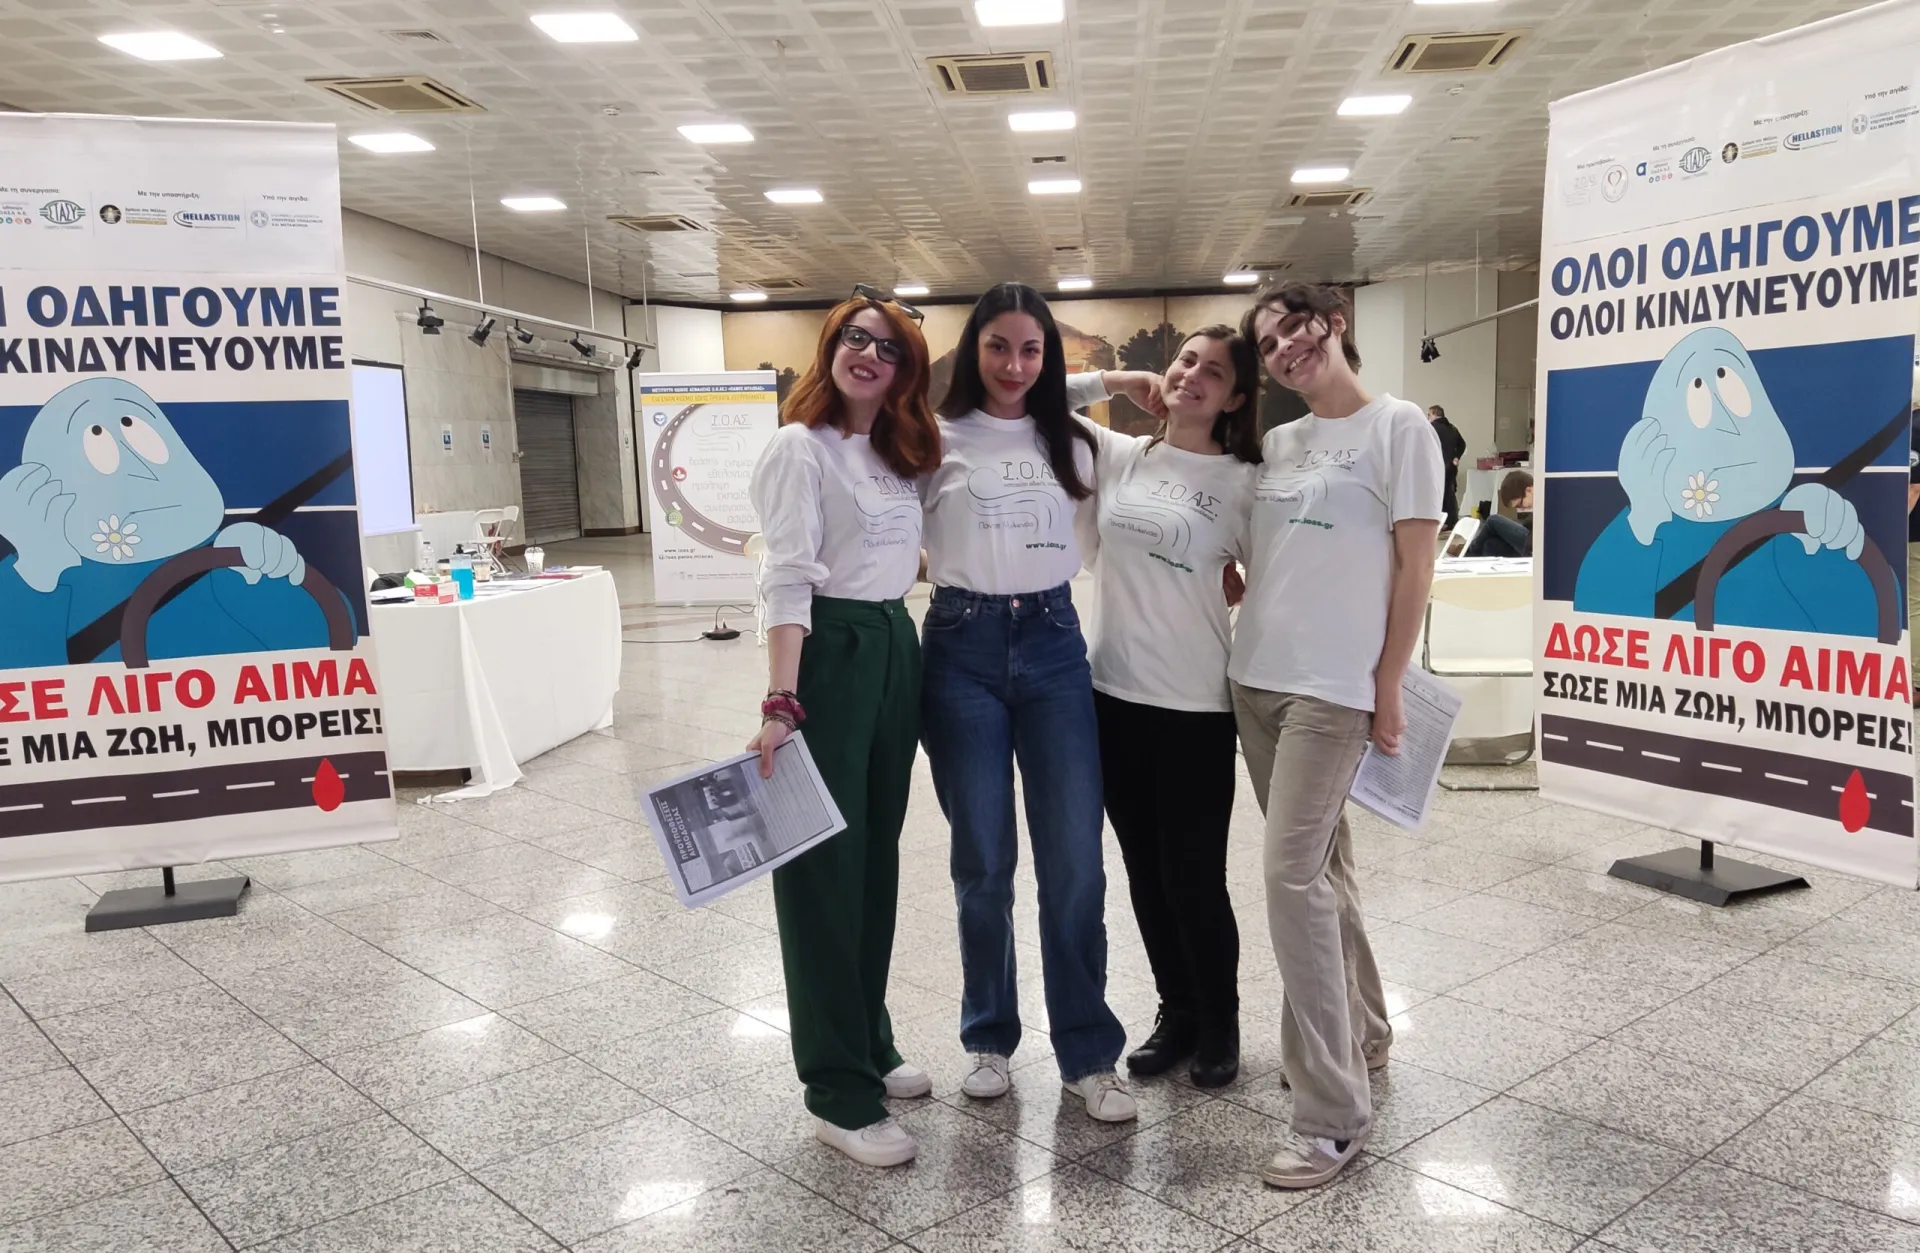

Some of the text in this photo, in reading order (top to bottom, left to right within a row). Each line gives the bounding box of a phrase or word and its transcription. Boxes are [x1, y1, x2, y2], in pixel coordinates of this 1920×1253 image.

[1792, 125, 1843, 143] HELLASTRON
[183, 213, 241, 221] HELLASTRON
[1552, 195, 1920, 296] ΟΛΟΙ ΟΔΗΓΟΥΜΕ
[27, 286, 341, 327] ΟΔΗΓΟΥΜΕ
[1550, 254, 1919, 340] ΟΛΟΙ ΚΙΝΔΥΝΕΥΟΥΜΕ
[0, 336, 345, 373] ΚΙΝΔΥΝΕΥΟΥΜΕ
[87, 669, 216, 716] ΛΙΓΟ
[233, 658, 377, 705] ΑΙΜΑ
[1544, 622, 1910, 704] ΔΩΣΕ ΛΙΓΟ ΑΙΜΑ
[22, 731, 98, 764] ΜΙΑ
[107, 724, 197, 757] ΖΩΗ,
[207, 708, 383, 748] ΜΠΟΡΕΙΣ!
[1543, 671, 1913, 755] ΣΩΣΕ ΜΙΑ ΖΩΗ, ΜΠΟΡΕΙΣ!
